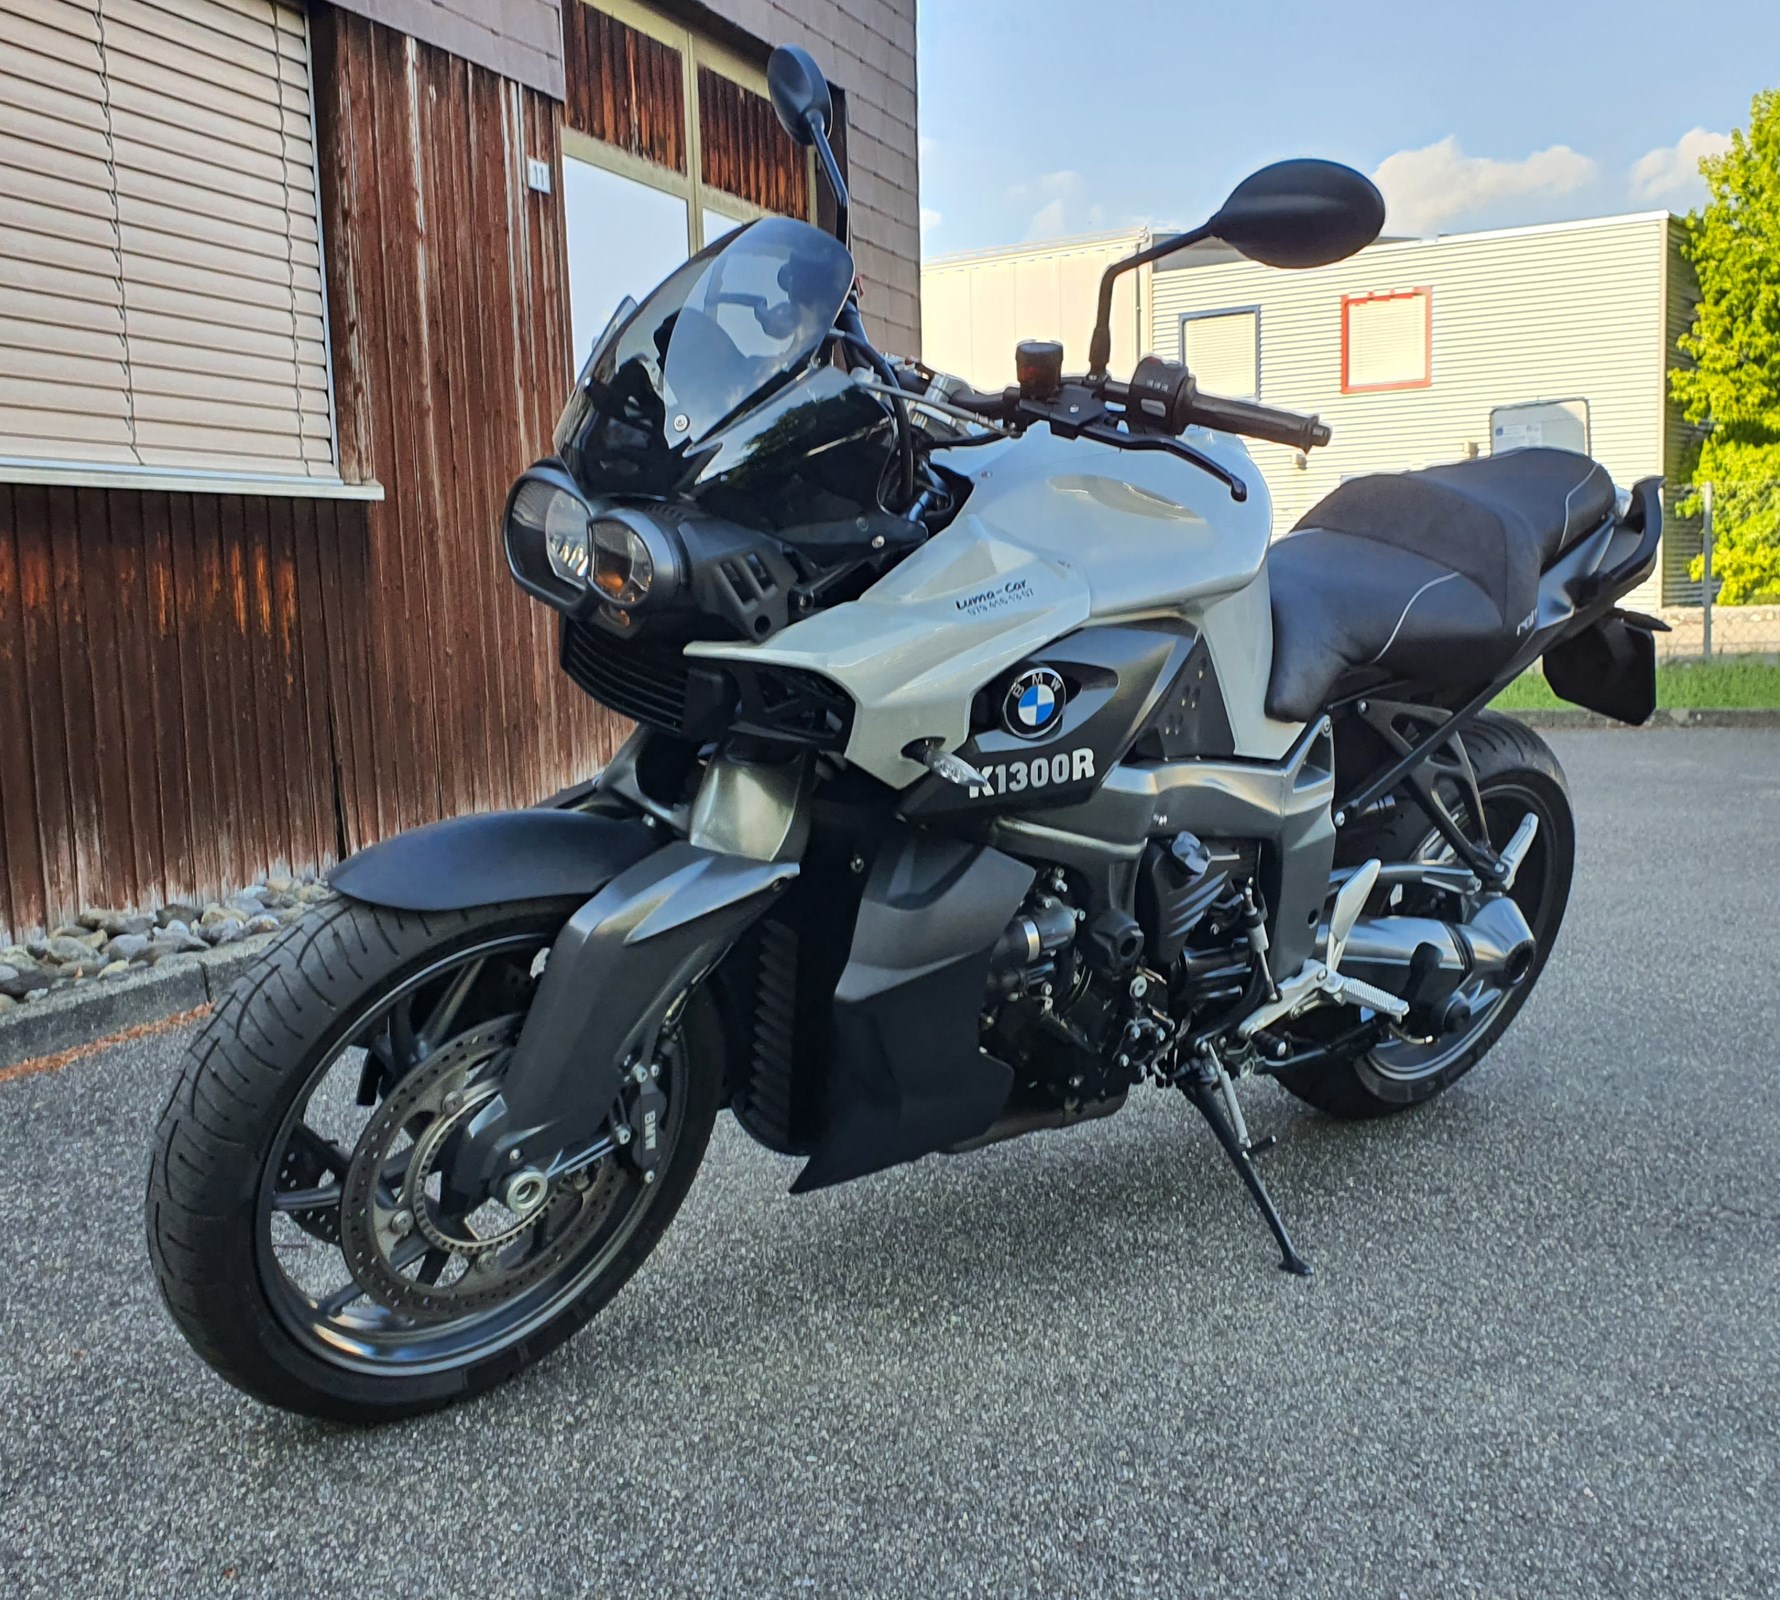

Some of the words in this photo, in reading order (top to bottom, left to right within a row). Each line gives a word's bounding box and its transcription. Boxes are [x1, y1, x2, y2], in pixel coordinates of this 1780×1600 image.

[533, 164, 545, 188] 11
[1012, 672, 1062, 699] BMW
[969, 747, 1096, 799] K1300R
